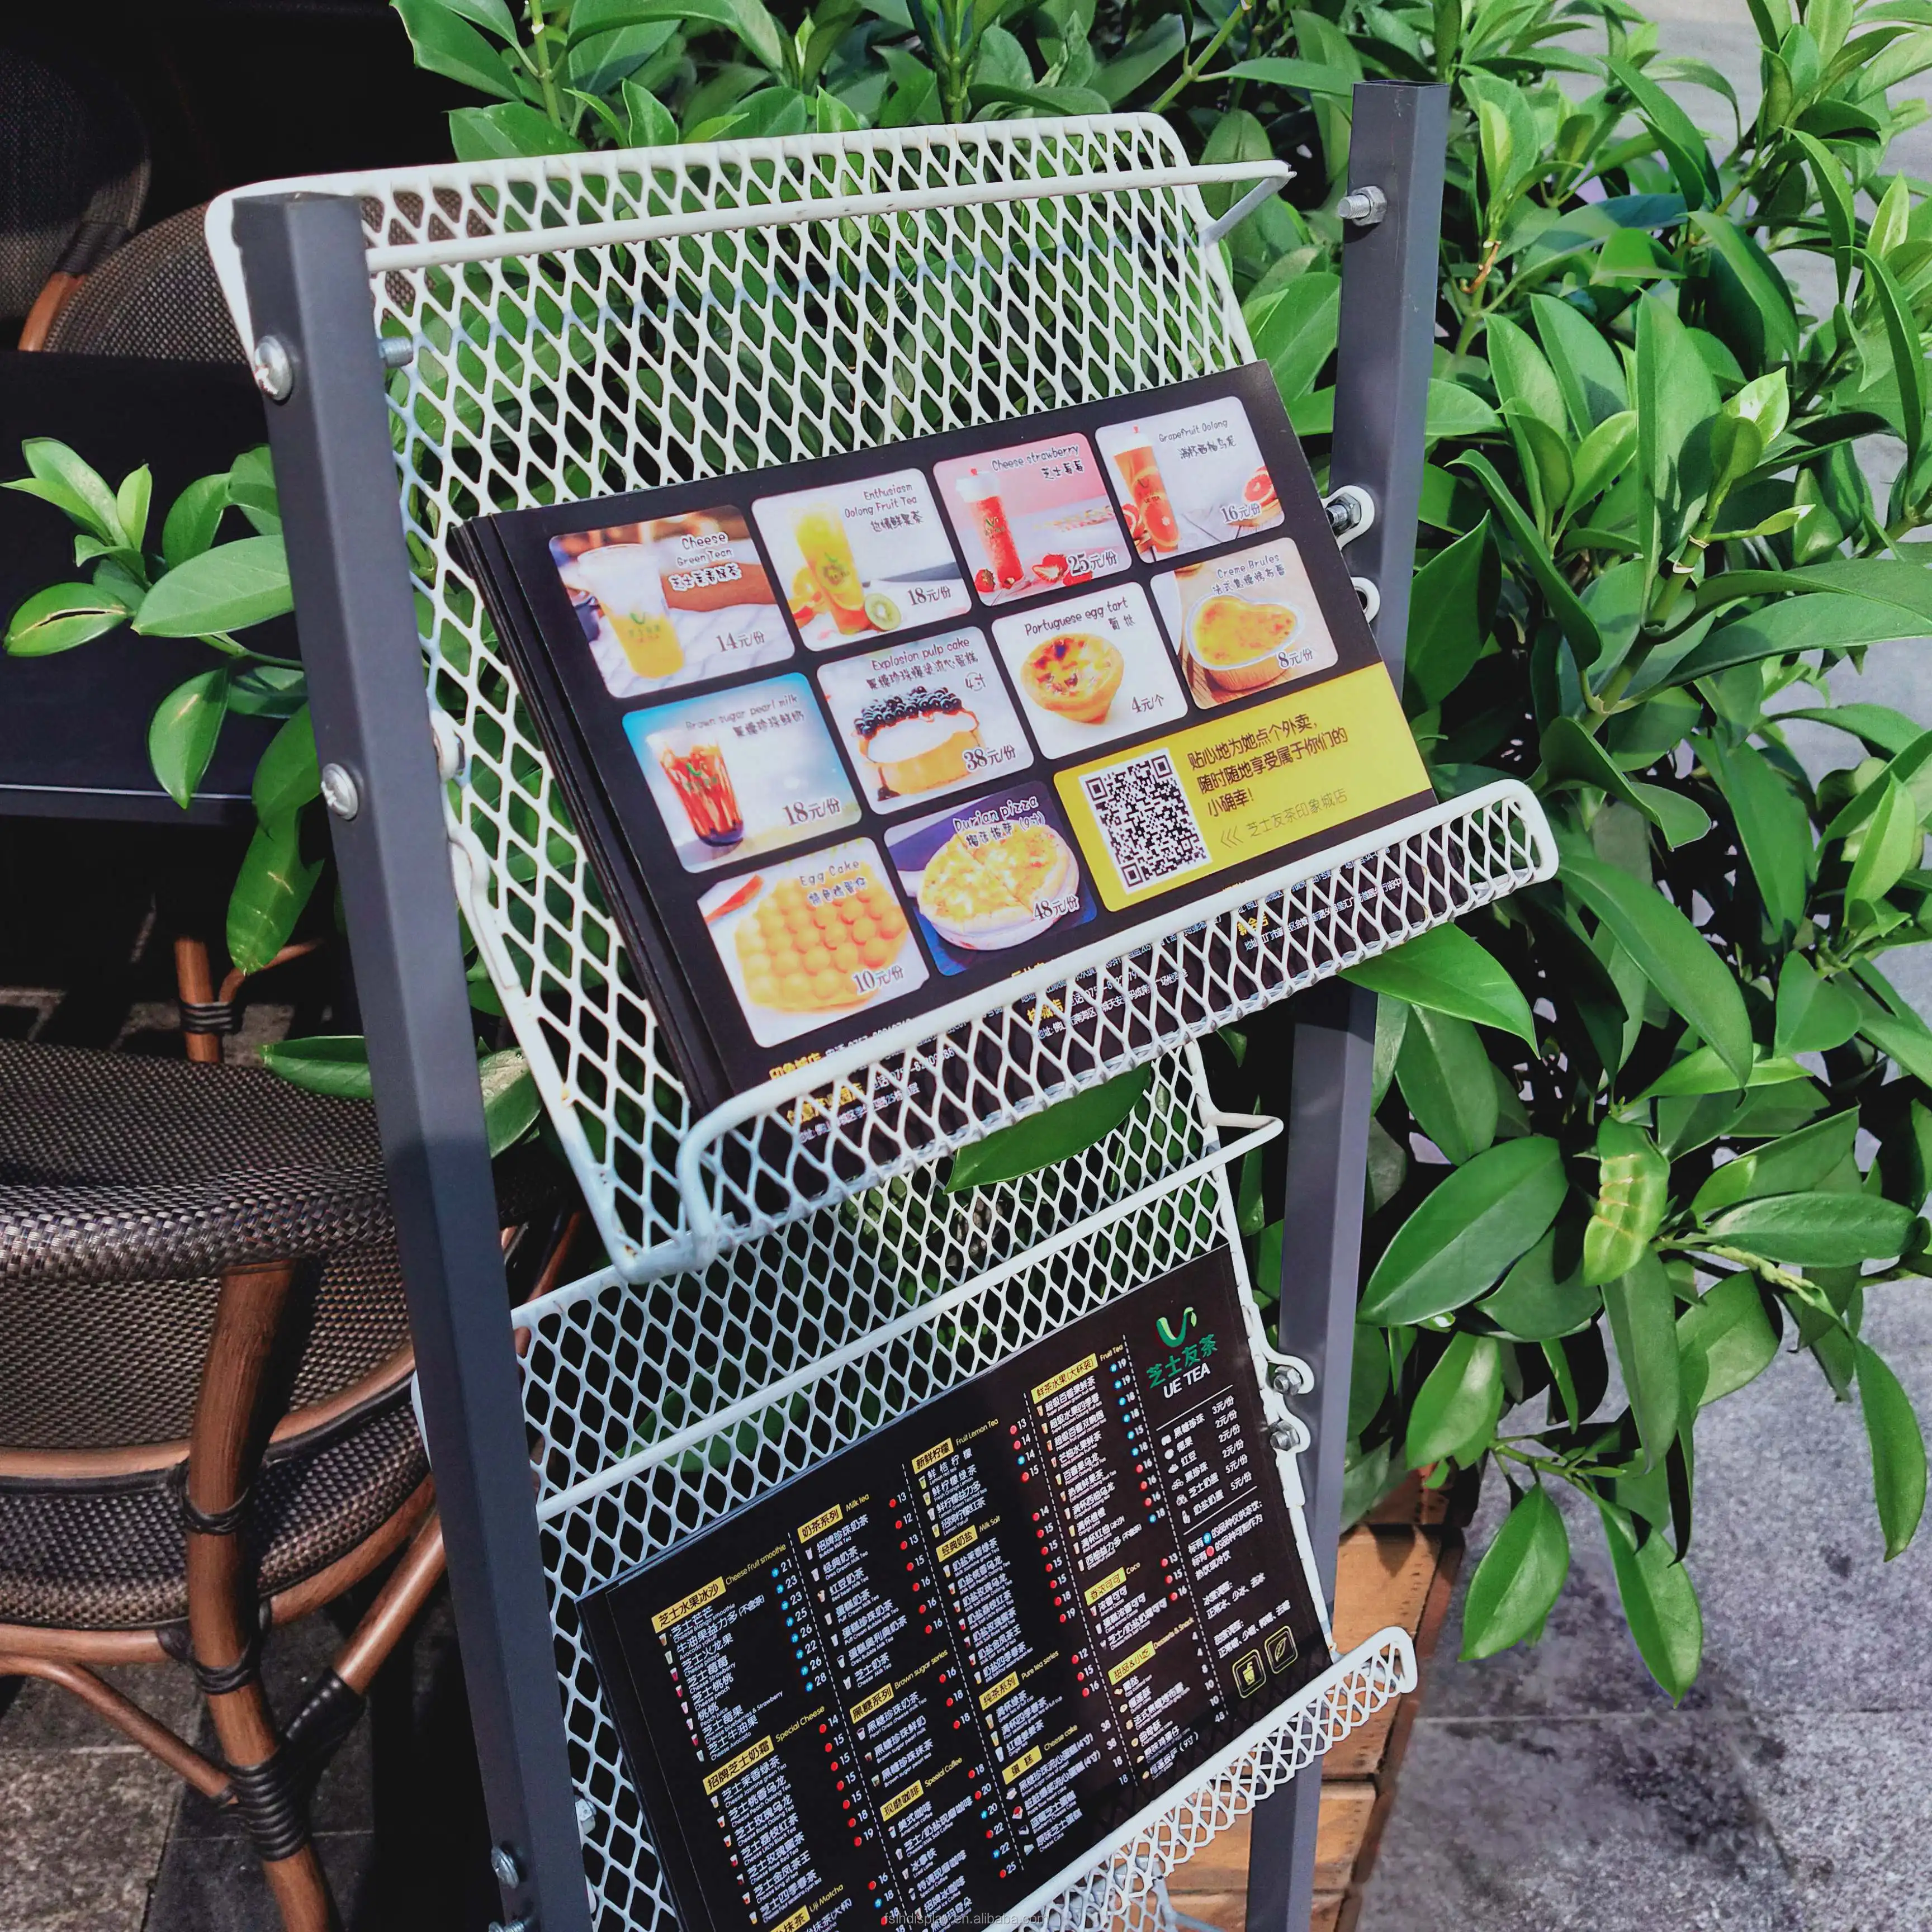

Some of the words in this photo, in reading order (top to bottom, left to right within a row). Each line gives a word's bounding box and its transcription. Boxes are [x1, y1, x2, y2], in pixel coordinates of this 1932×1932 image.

[1159, 425, 1200, 443] Grapefruit
[1202, 420, 1228, 433] Oolong
[992, 456, 1024, 471] Cheese
[1026, 445, 1079, 463] strawberry
[863, 483, 913, 501] Enthusiasm
[845, 505, 874, 519] Oolong
[876, 499, 899, 513] Fruit
[900, 495, 917, 506] Tea
[1219, 503, 1262, 524] 16元/份
[681, 532, 727, 551] Cheese
[676, 553, 706, 567] Green
[1067, 550, 1117, 575] 25元/份
[1216, 564, 1246, 579] Creme
[1248, 555, 1280, 570] Brules
[907, 584, 951, 607] 18元/份
[1024, 613, 1082, 637] Portuguese
[1085, 605, 1104, 619] egg
[1107, 595, 1129, 613] tart
[716, 631, 765, 652] 14元/份
[872, 651, 920, 671] Explosion
[922, 643, 944, 661] pulp
[947, 637, 970, 652] cake
[1278, 647, 1313, 668] 8元/份
[685, 718, 717, 731] Brown
[718, 711, 746, 724] sugar
[750, 699, 775, 716] pearl
[778, 694, 798, 708] milk
[1131, 694, 1164, 714] 4元/个
[963, 744, 1016, 771] 38元/份
[1196, 726, 1349, 795] 随时随地享受属于你们的
[783, 797, 841, 826] 18元/份
[953, 809, 1000, 832] Durian
[1000, 795, 1039, 818] pizza
[1246, 788, 1348, 839] 芝士友茶印象城店
[799, 872, 825, 887] Egg
[828, 860, 860, 877] Cake
[1034, 894, 1080, 921] 48元/份
[853, 964, 904, 994] 10元/份
[1099, 1349, 1113, 1362] Fruit
[1112, 1343, 1124, 1355] Tea
[1147, 1334, 1219, 1389] 芝士友茶
[1117, 1357, 1127, 1370] 19
[1121, 1374, 1131, 1386] 19
[1163, 1377, 1182, 1398] UE
[1183, 1362, 1211, 1385] TEA
[1211, 1395, 1234, 1414] 3元/份
[1017, 1417, 1027, 1430] 13
[1215, 1409, 1238, 1429] 2元/份
[955, 1433, 969, 1447] Fruit
[968, 1423, 988, 1439] Lemon
[987, 1418, 999, 1429] Tea
[1021, 1433, 1031, 1446] 14
[1134, 1424, 1144, 1436] 15
[1218, 1423, 1241, 1443] 2元/份
[1029, 1464, 1040, 1477] 15
[1225, 1453, 1248, 1474] 5元/份
[1230, 1471, 1253, 1491] 5元/份
[845, 1500, 860, 1512] Milk
[897, 1491, 907, 1504] 13
[903, 1512, 913, 1525] 12
[1040, 1505, 1050, 1517] 14
[801, 1508, 840, 1540] 奶茶系列
[725, 1568, 748, 1585] Cheese
[747, 1559, 760, 1573] Fruit
[760, 1543, 787, 1565] smoothie
[915, 1554, 925, 1567] 15
[1125, 1562, 1141, 1575] Coco
[785, 1574, 798, 1589] 23
[1173, 1568, 1183, 1580] 15
[657, 1583, 719, 1628] 芝士水果冰沙
[670, 1605, 714, 1638] 芝士芒芒
[780, 1557, 793, 1573] 21
[794, 1607, 808, 1622] 25
[1066, 1607, 1076, 1620] 19
[681, 1632, 734, 1673] 芝士火龙果
[790, 1591, 803, 1606] 23
[799, 1623, 812, 1639] 26
[932, 1617, 943, 1630] 16
[804, 1639, 818, 1655] 22
[894, 1672, 914, 1690] Brown
[913, 1661, 931, 1677] sugar
[930, 1649, 949, 1665] series
[946, 1666, 957, 1679] 16
[1021, 1668, 1035, 1680] Pure
[1043, 1650, 1060, 1665] series
[815, 1671, 827, 1687] 28
[1089, 1679, 1100, 1693] 16
[1205, 1679, 1215, 1690] 10
[953, 1689, 964, 1702] 18
[775, 1721, 800, 1742] Special
[799, 1706, 825, 1726] Cheese
[827, 1714, 839, 1727] 14
[1100, 1719, 1111, 1733] 38
[833, 1733, 845, 1746] 15
[1043, 1734, 1065, 1751] Cheese
[974, 1763, 985, 1776] 18
[981, 1782, 992, 1796] 20
[858, 1808, 869, 1822] 18
[863, 1827, 874, 1840] 19
[818, 1883, 844, 1906] Matcha
